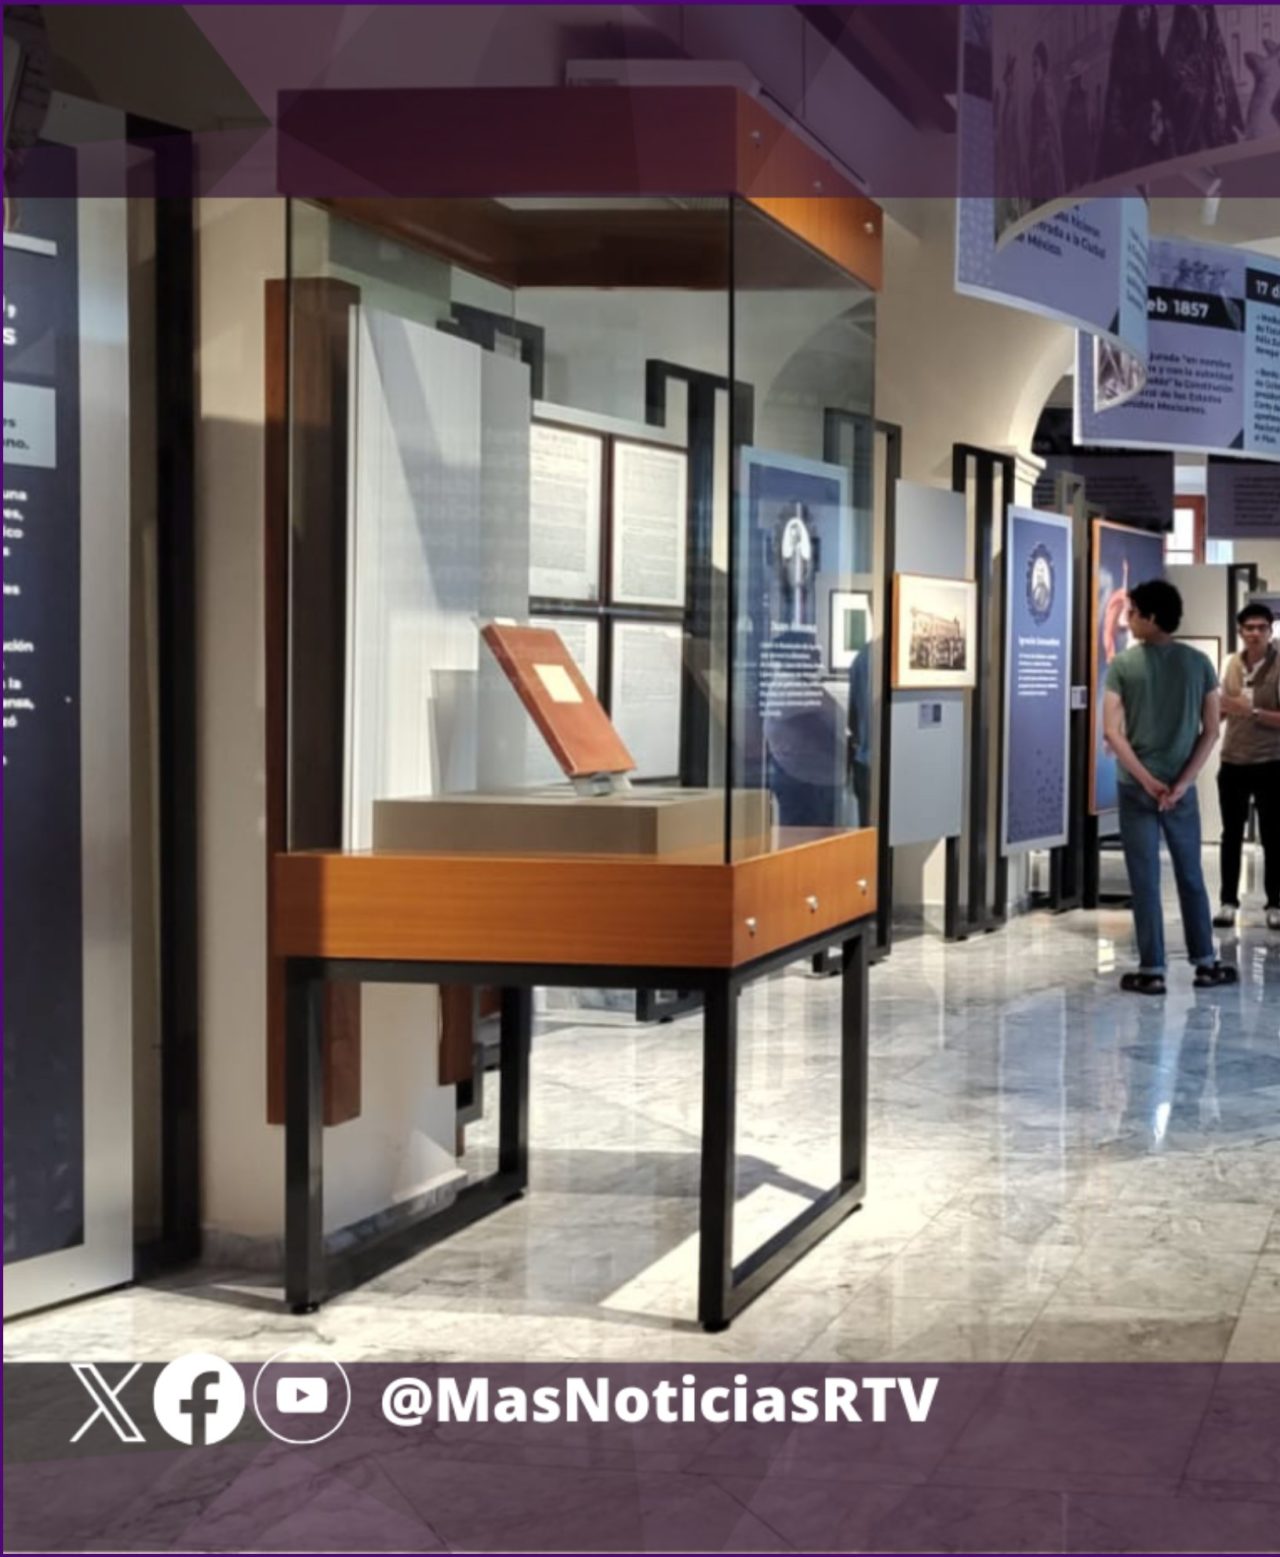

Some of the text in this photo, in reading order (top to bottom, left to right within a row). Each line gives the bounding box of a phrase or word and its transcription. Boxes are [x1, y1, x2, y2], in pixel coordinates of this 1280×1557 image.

[1256, 279, 1269, 297] 17
[1147, 296, 1210, 318] eb 1857
